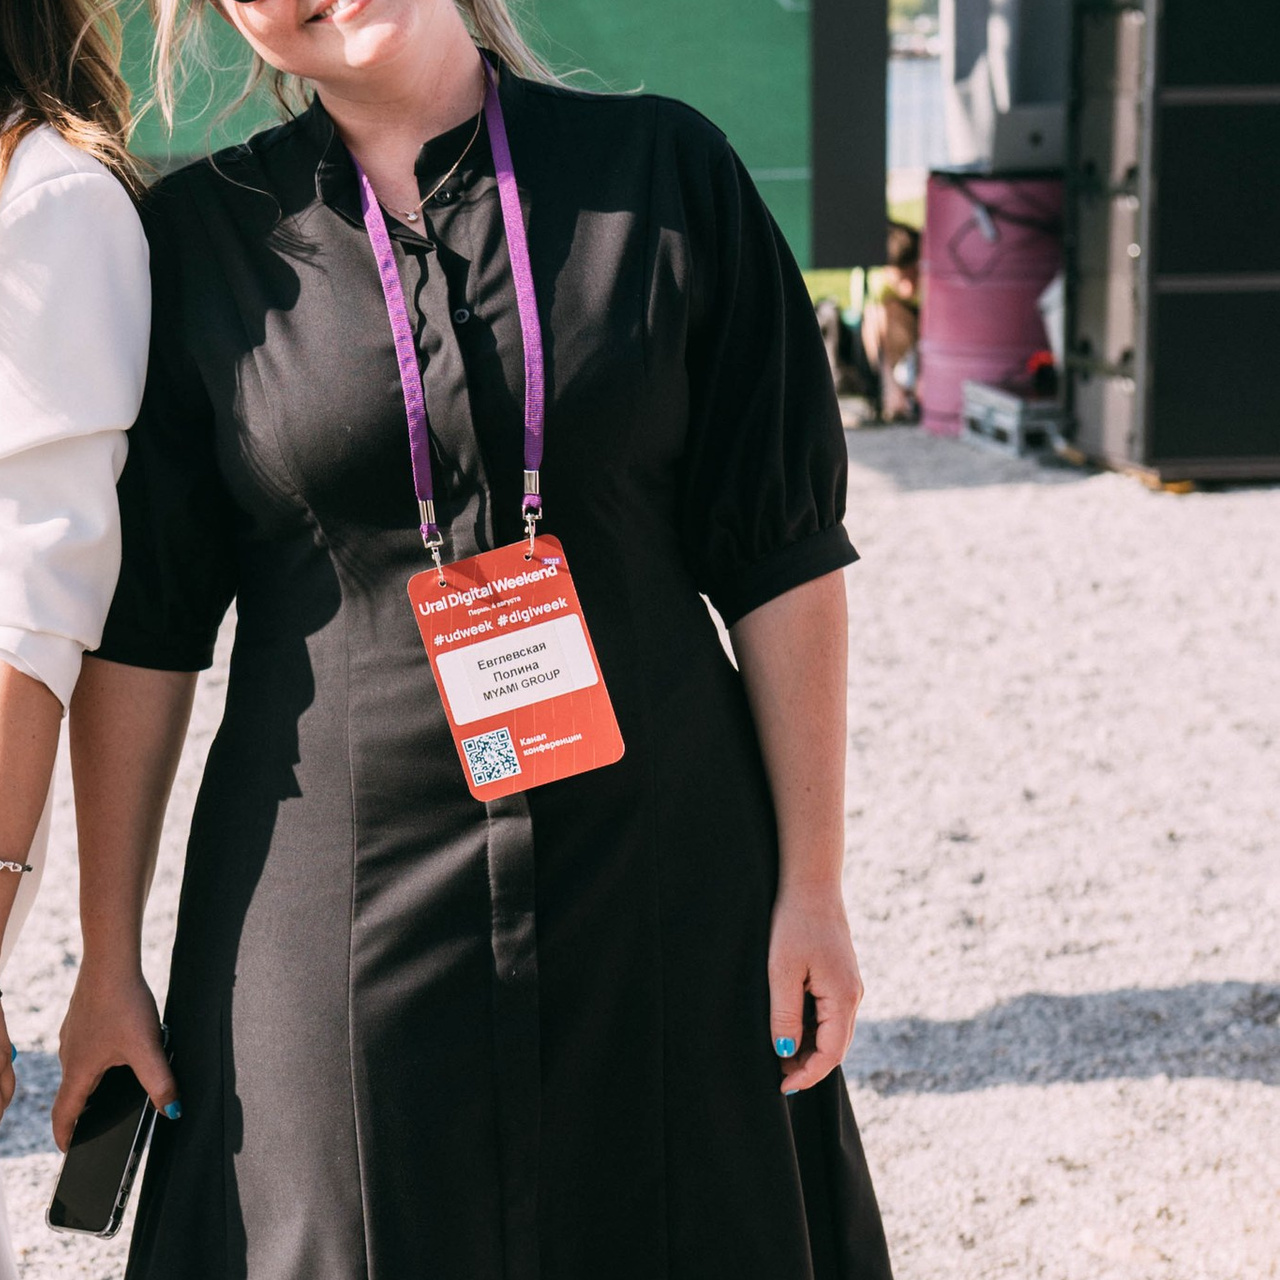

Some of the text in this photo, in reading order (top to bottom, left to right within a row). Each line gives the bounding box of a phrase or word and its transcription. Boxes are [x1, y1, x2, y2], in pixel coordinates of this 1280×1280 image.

[418, 565, 558, 616] Ural Digital Weekend
[468, 607, 491, 616] Пермь,
[496, 596, 521, 608] августа
[434, 597, 568, 646] #udweek #digiweek
[477, 642, 547, 671] Евглевская
[493, 661, 539, 682] Полина
[482, 669, 560, 701] MYAMI GROUP
[520, 733, 547, 746] Канал
[523, 733, 582, 757] конференции
